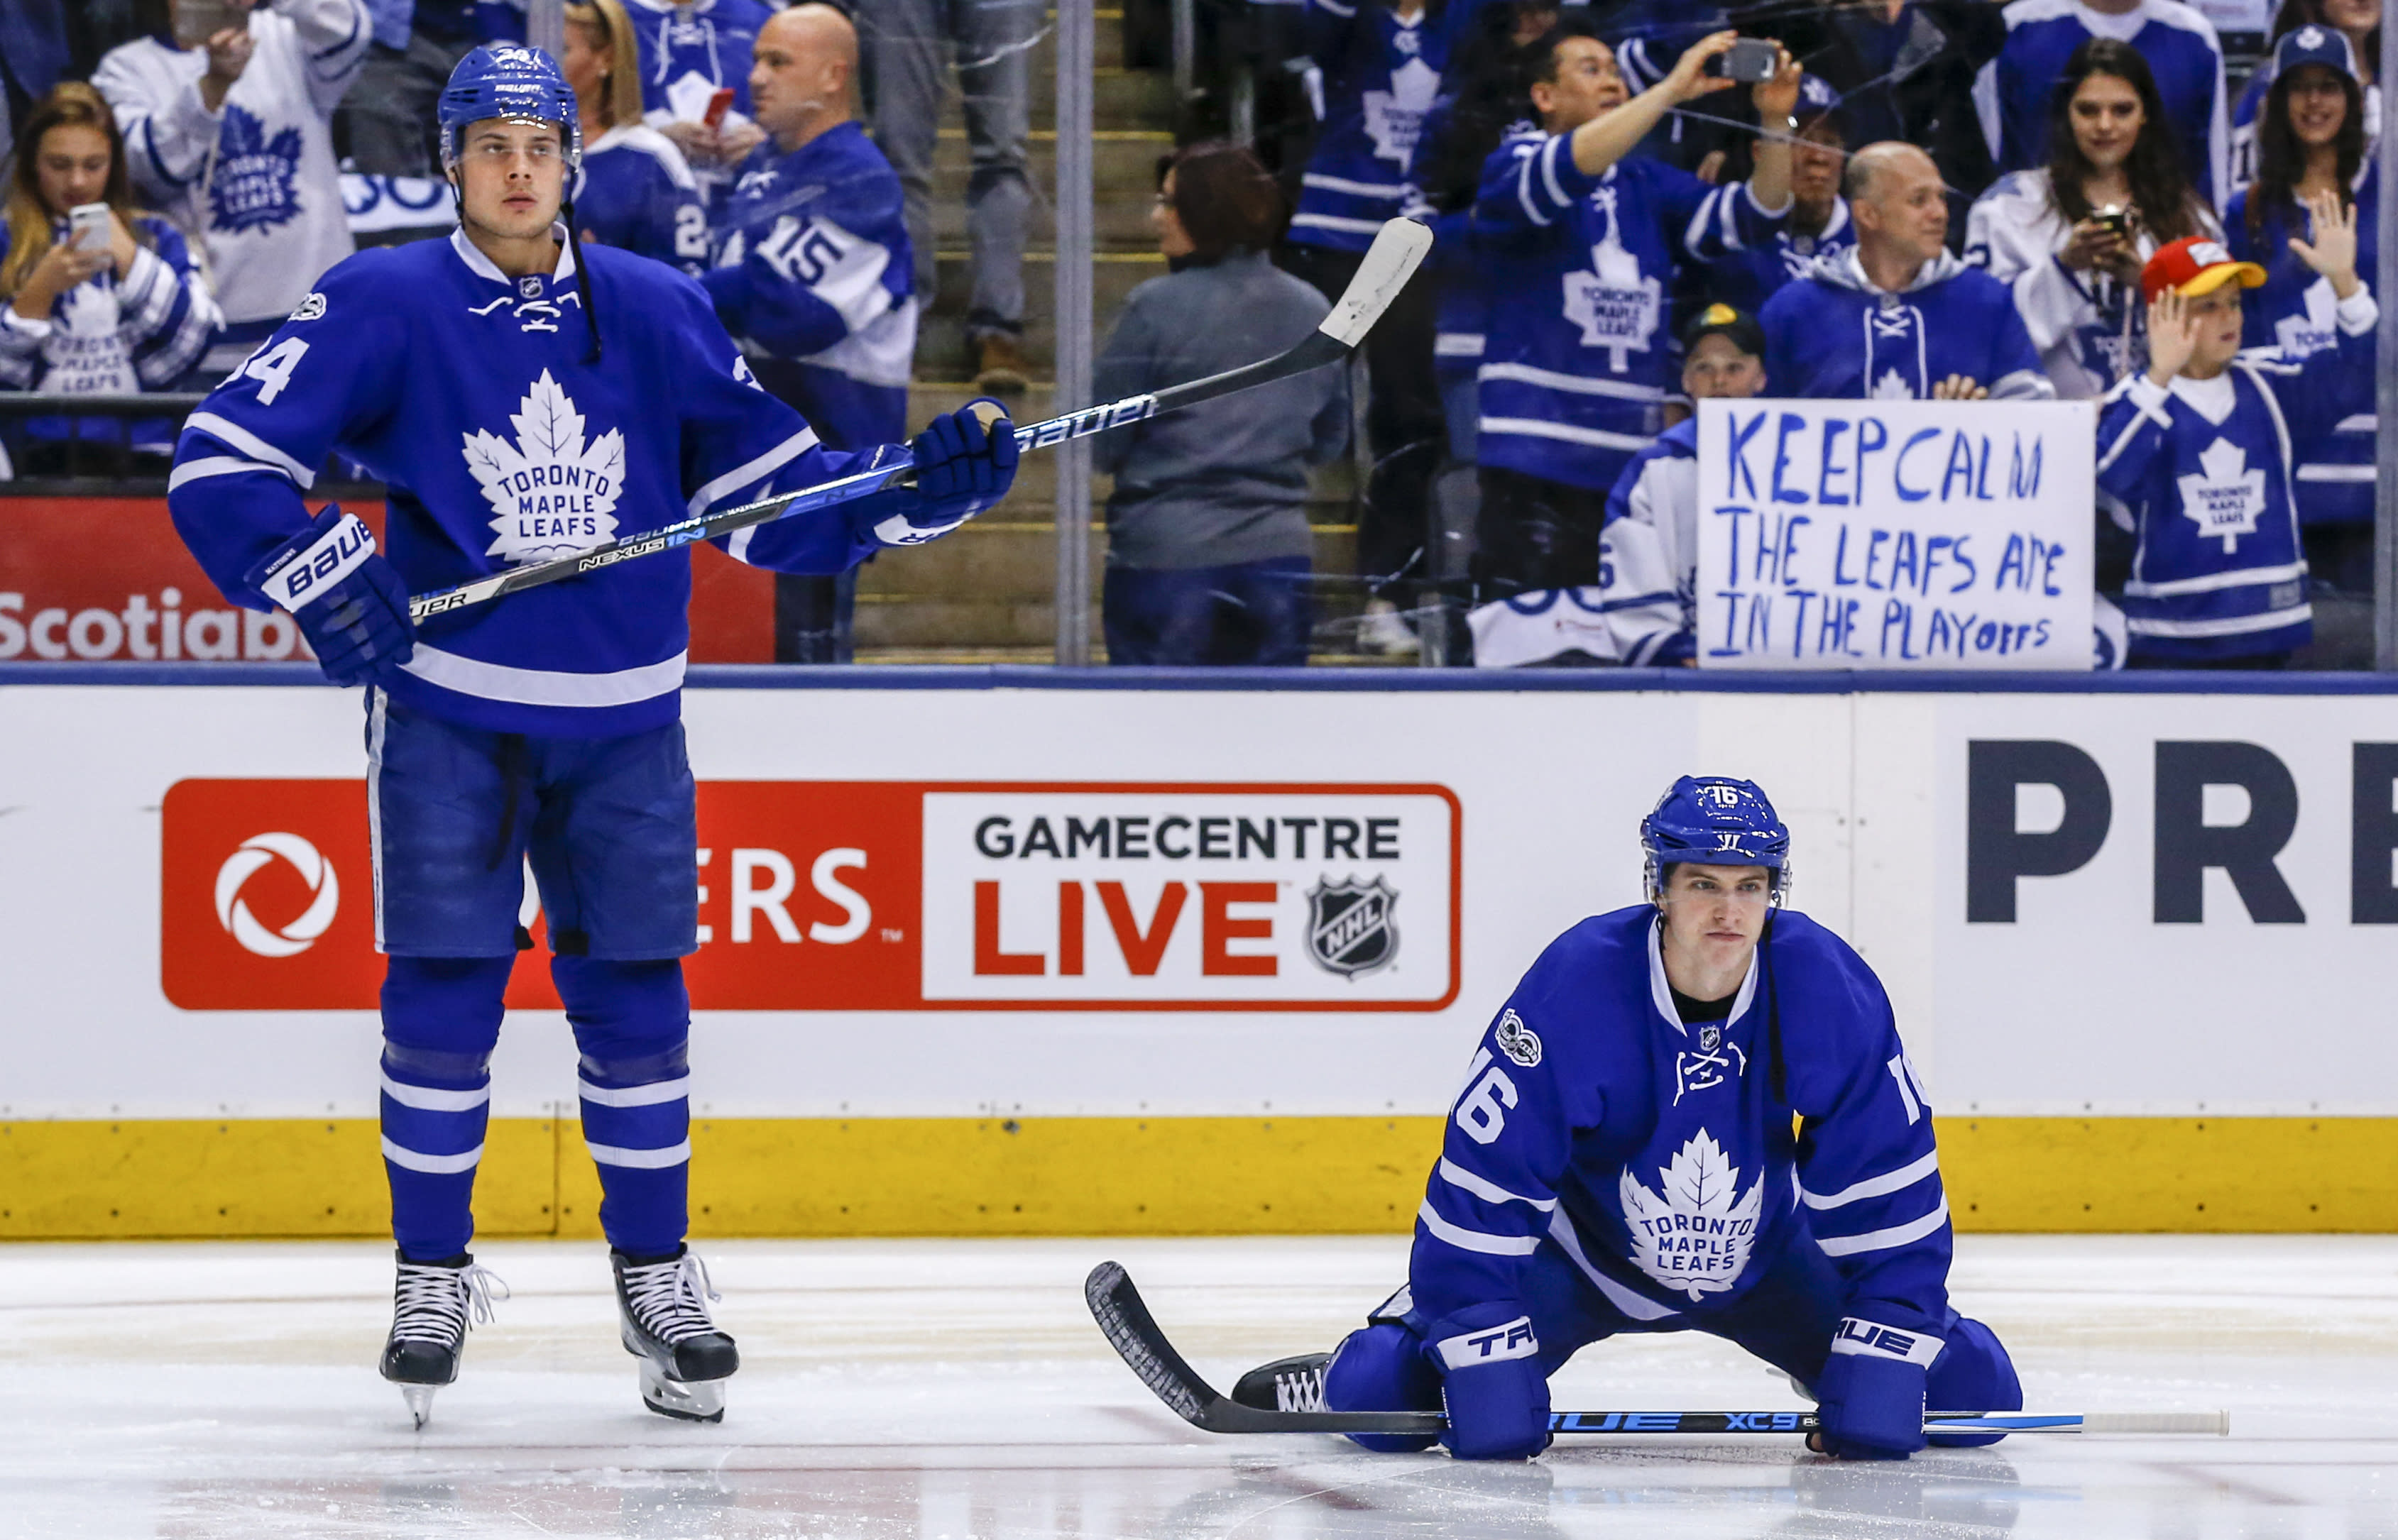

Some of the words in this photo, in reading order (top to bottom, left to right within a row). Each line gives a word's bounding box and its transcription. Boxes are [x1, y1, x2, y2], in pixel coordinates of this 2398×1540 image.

[1728, 411, 1888, 507] KEEP
[1894, 427, 2042, 502] CALM
[498, 465, 610, 497] TORONTO
[519, 495, 596, 515] MAPLE
[519, 517, 596, 537] LEAFS
[579, 537, 665, 572] NEXUS
[1713, 506, 1812, 588] THE
[1834, 523, 1978, 597] LEAFS
[1708, 591, 1773, 656] IN
[1784, 590, 1863, 659] THE
[974, 815, 1401, 860] GAMECENTRE
[974, 880, 1278, 977] LIVE
[1325, 903, 1381, 955] NHL
[1640, 1214, 1753, 1237] TORONTO
[1658, 1236, 1736, 1255] MAPLE
[1657, 1255, 1735, 1271] LEAFS
[1725, 1413, 1798, 1431] XC9
